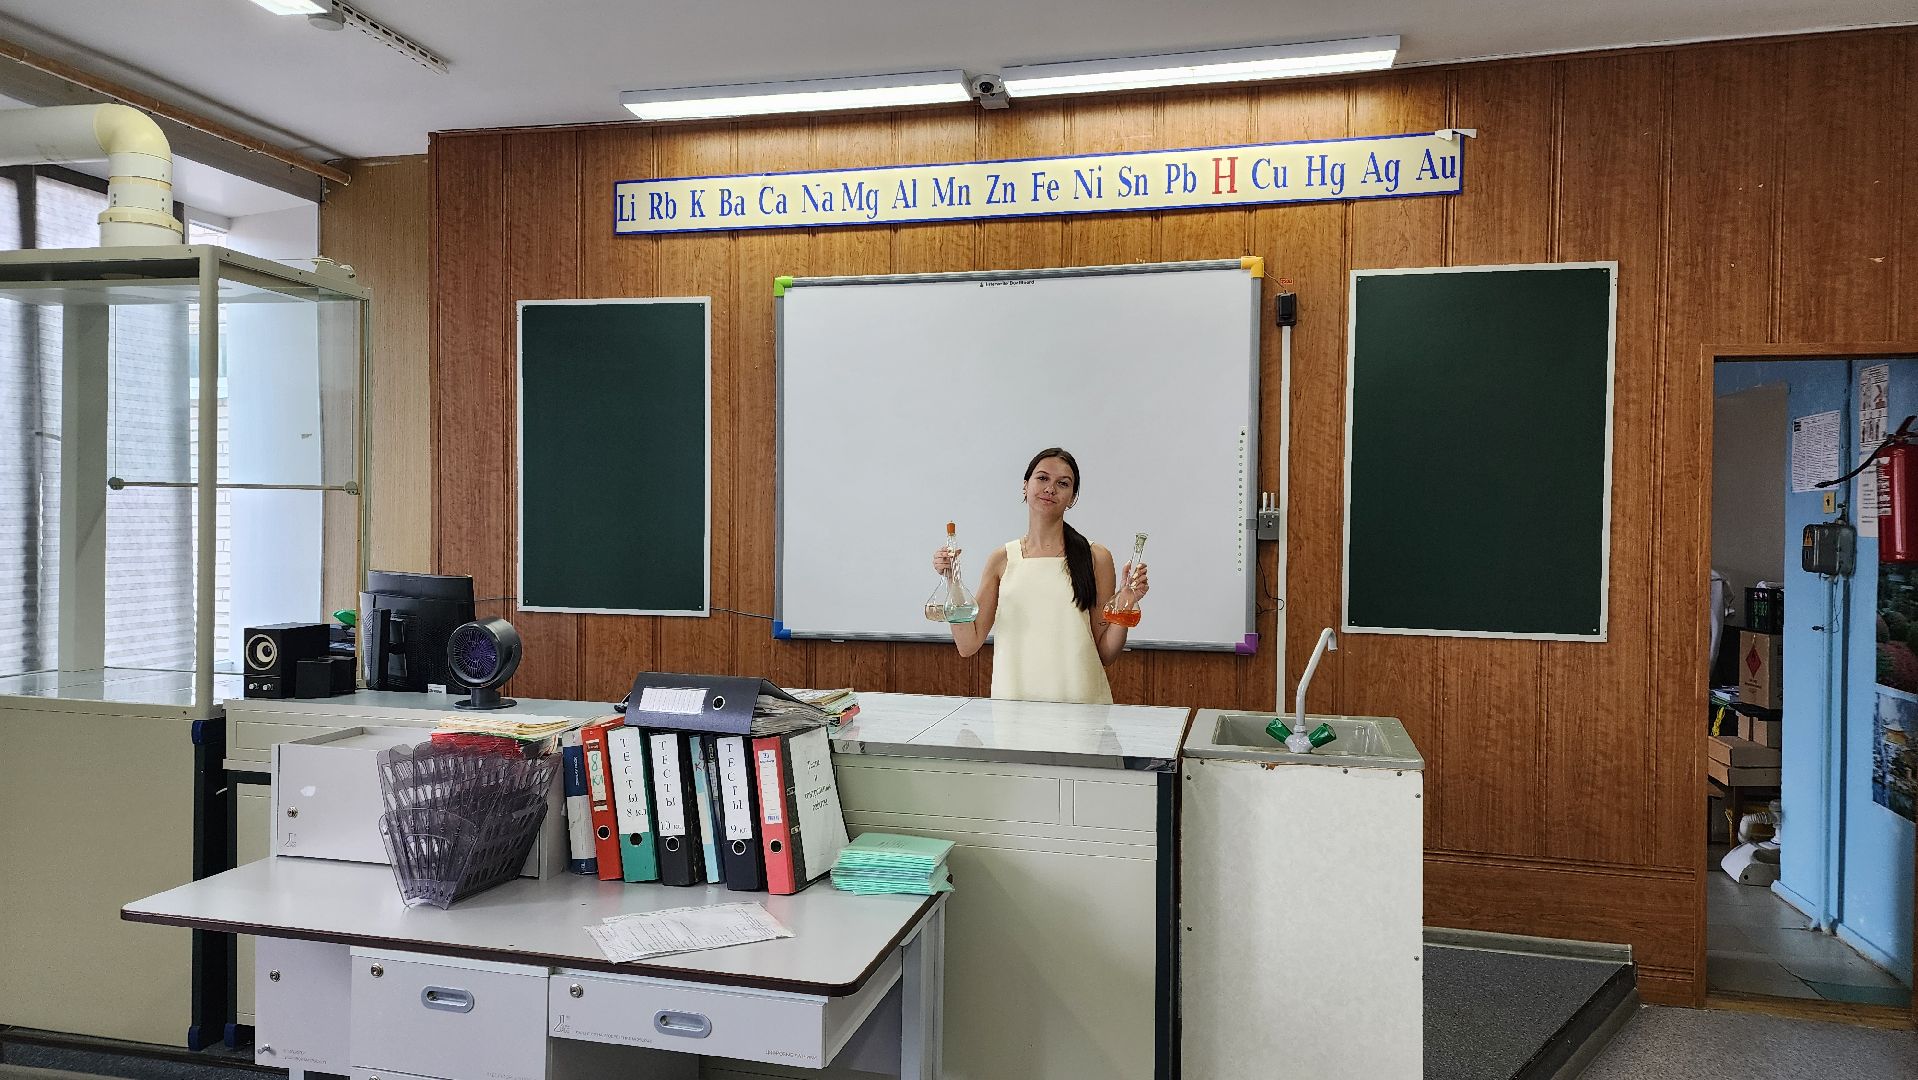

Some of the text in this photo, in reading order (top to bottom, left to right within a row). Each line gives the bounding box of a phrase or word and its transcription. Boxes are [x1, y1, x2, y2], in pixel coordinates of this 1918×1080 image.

[618, 148, 1457, 223] Li Rb K Ba Ca Na Mg Al Mn Zn Fe Ni Sn Pb H Cu Hg Ag Au
[620, 738, 638, 803] ТЕСТЫ
[659, 740, 676, 807] ТЕСТЫ
[726, 743, 743, 810] ТЕСТЫ
[661, 820, 671, 831] 10
[730, 824, 737, 834] 9
